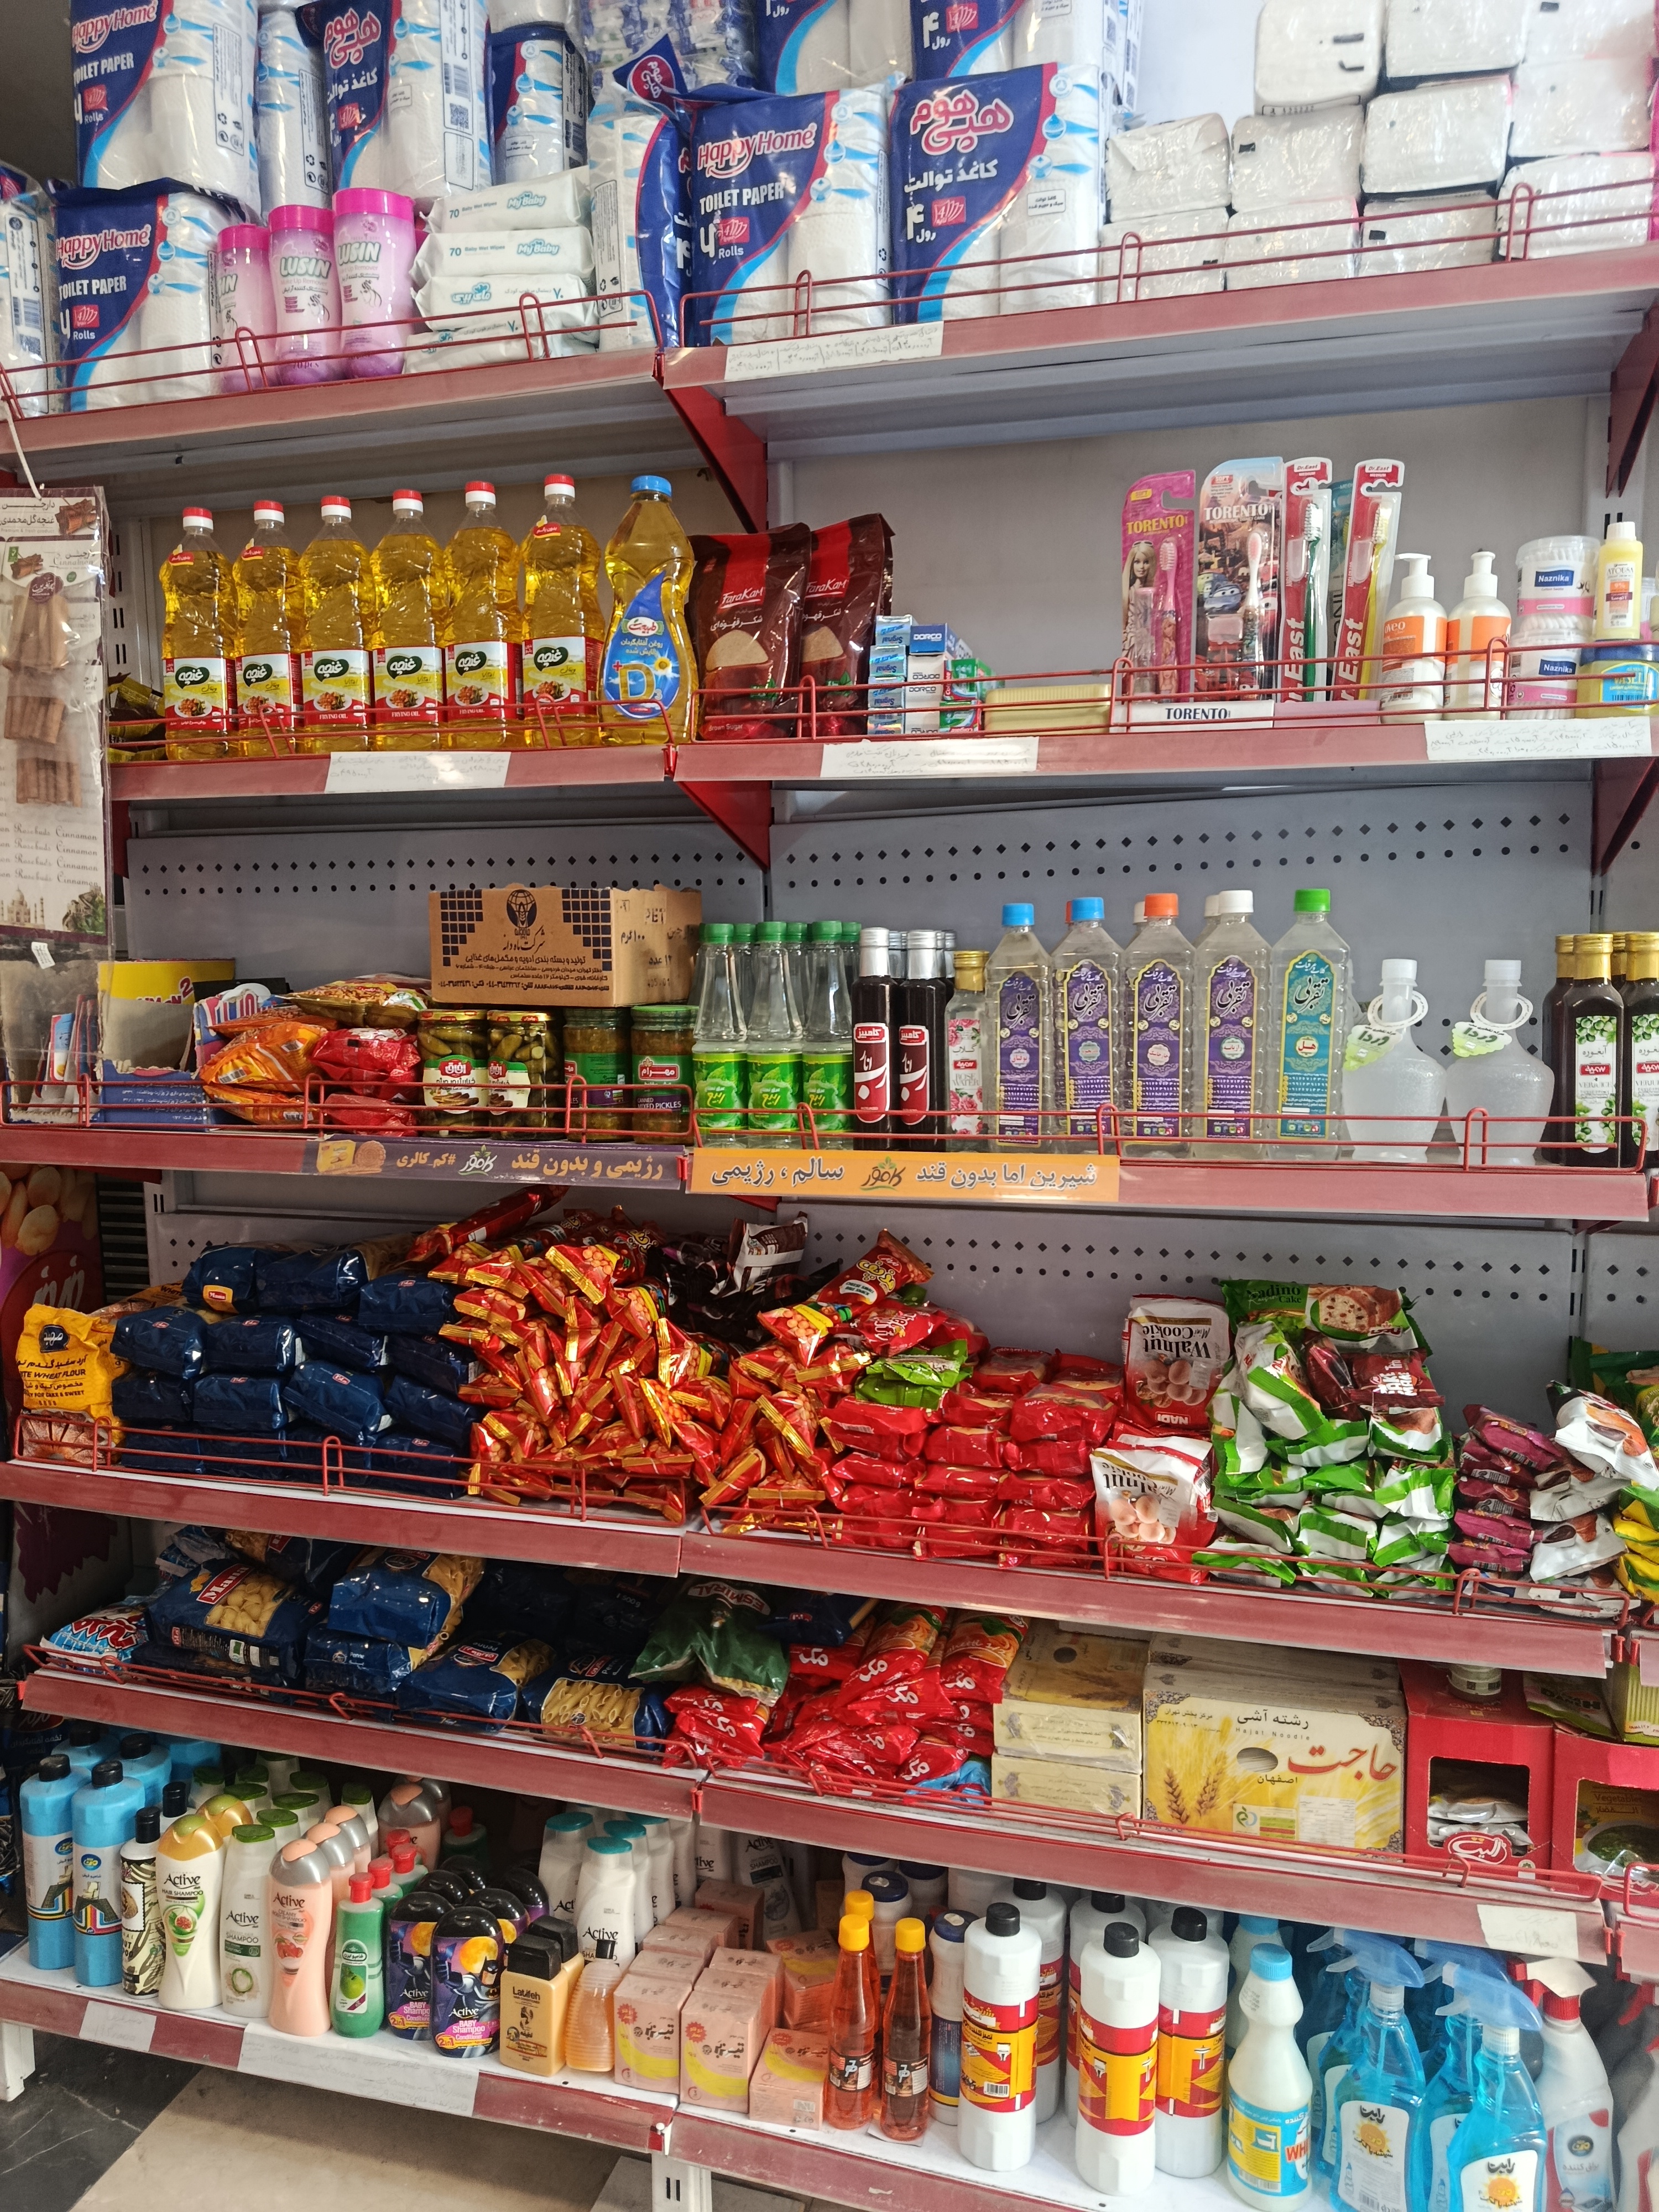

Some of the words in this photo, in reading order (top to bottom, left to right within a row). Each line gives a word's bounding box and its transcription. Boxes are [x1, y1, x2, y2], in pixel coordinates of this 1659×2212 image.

[110, 2, 156, 28] Home
[932, 35, 951, 50] رول
[101, 53, 135, 75] PAPER
[351, 66, 378, 91] کاغذ
[84, 112, 104, 124] Rolls
[910, 90, 980, 135] هوم
[921, 98, 1014, 155] هپی
[697, 133, 758, 179] Happy
[757, 127, 815, 156] Home
[956, 159, 999, 184] کاغذ
[904, 169, 954, 195] توالت
[507, 197, 522, 211] My
[521, 194, 547, 209] Baby
[700, 189, 739, 213] TOILET
[742, 182, 785, 205] PAPER
[450, 208, 460, 219] 70
[100, 226, 151, 251] Home
[915, 229, 937, 244] رول
[338, 241, 382, 266] LUSIN
[450, 247, 462, 257] 70
[517, 243, 533, 256] My
[532, 241, 560, 255] Baby
[718, 244, 744, 259] Rolls
[280, 256, 332, 279] LUSIN
[59, 279, 92, 302] TOILET
[95, 276, 127, 295] PAPER
[72, 328, 96, 341] Rolls
[1296, 463, 1319, 472] Dr.East
[1368, 464, 1391, 472] Dr.East
[2, 499, 56, 511] دارچین
[1204, 503, 1269, 521] TORENTO
[1126, 514, 1186, 535] TORENTO
[1538, 575, 1570, 583] Naznika
[738, 614, 764, 628] شکر
[1543, 663, 1573, 674] Naznika
[1165, 707, 1228, 721] TORENTO
[55, 825, 98, 841] Cinnamon
[56, 840, 98, 857] Cinnamon
[56, 855, 99, 872] Cinnamon
[57, 870, 99, 886] Cinnamon
[465, 953, 483, 962] غذایی
[571, 955, 586, 965] تولید
[179, 977, 194, 998] 2
[1297, 1041, 1317, 1051] هل
[641, 1067, 676, 1077] مهرام
[951, 1078, 979, 1087] WATER
[655, 1100, 682, 1109] PICKLES
[510, 1149, 540, 1171] قند
[542, 1154, 588, 1177] بدون
[593, 1160, 603, 1176] و
[606, 1156, 664, 1181] رژیمی
[711, 1162, 775, 1188] رژیمی
[792, 1155, 844, 1185] سالم
[916, 1162, 947, 1183] قند
[1002, 1164, 1025, 1182] اما
[950, 1166, 998, 1187] بدون
[1030, 1164, 1097, 1190] شیرین
[1279, 1295, 1302, 1304] Cake
[1142, 1324, 1194, 1339] Cookie
[1142, 1338, 1212, 1359] Walnut
[27, 1359, 55, 1369] گندم
[34, 1371, 61, 1380] WHEAT
[62, 1368, 86, 1377] FLOUR
[53, 1381, 84, 1391] مخصوص
[1157, 1413, 1189, 1425] NADI
[205, 1564, 251, 1604] Mana
[1236, 1708, 1269, 1725] آشی
[1272, 1712, 1310, 1730] رشته
[1235, 1726, 1266, 1736] Hajat
[1272, 1730, 1311, 1741] Noodle
[1287, 1743, 1399, 1782] حاجت
[1256, 1773, 1298, 1785] اصفهان
[163, 1873, 201, 1886] Active
[273, 1892, 306, 1908] Active
[226, 1910, 259, 1924] Active
[226, 1932, 259, 1944] SHAMPOO
[582, 1927, 619, 1941] Active
[400, 1989, 429, 1998] Active
[403, 2007, 430, 2015] Shampo
[448, 2007, 480, 2018] Active
[390, 2016, 405, 2027] 2in1
[452, 2025, 486, 2034] Shampoo
[438, 2037, 455, 2047] 2in1
